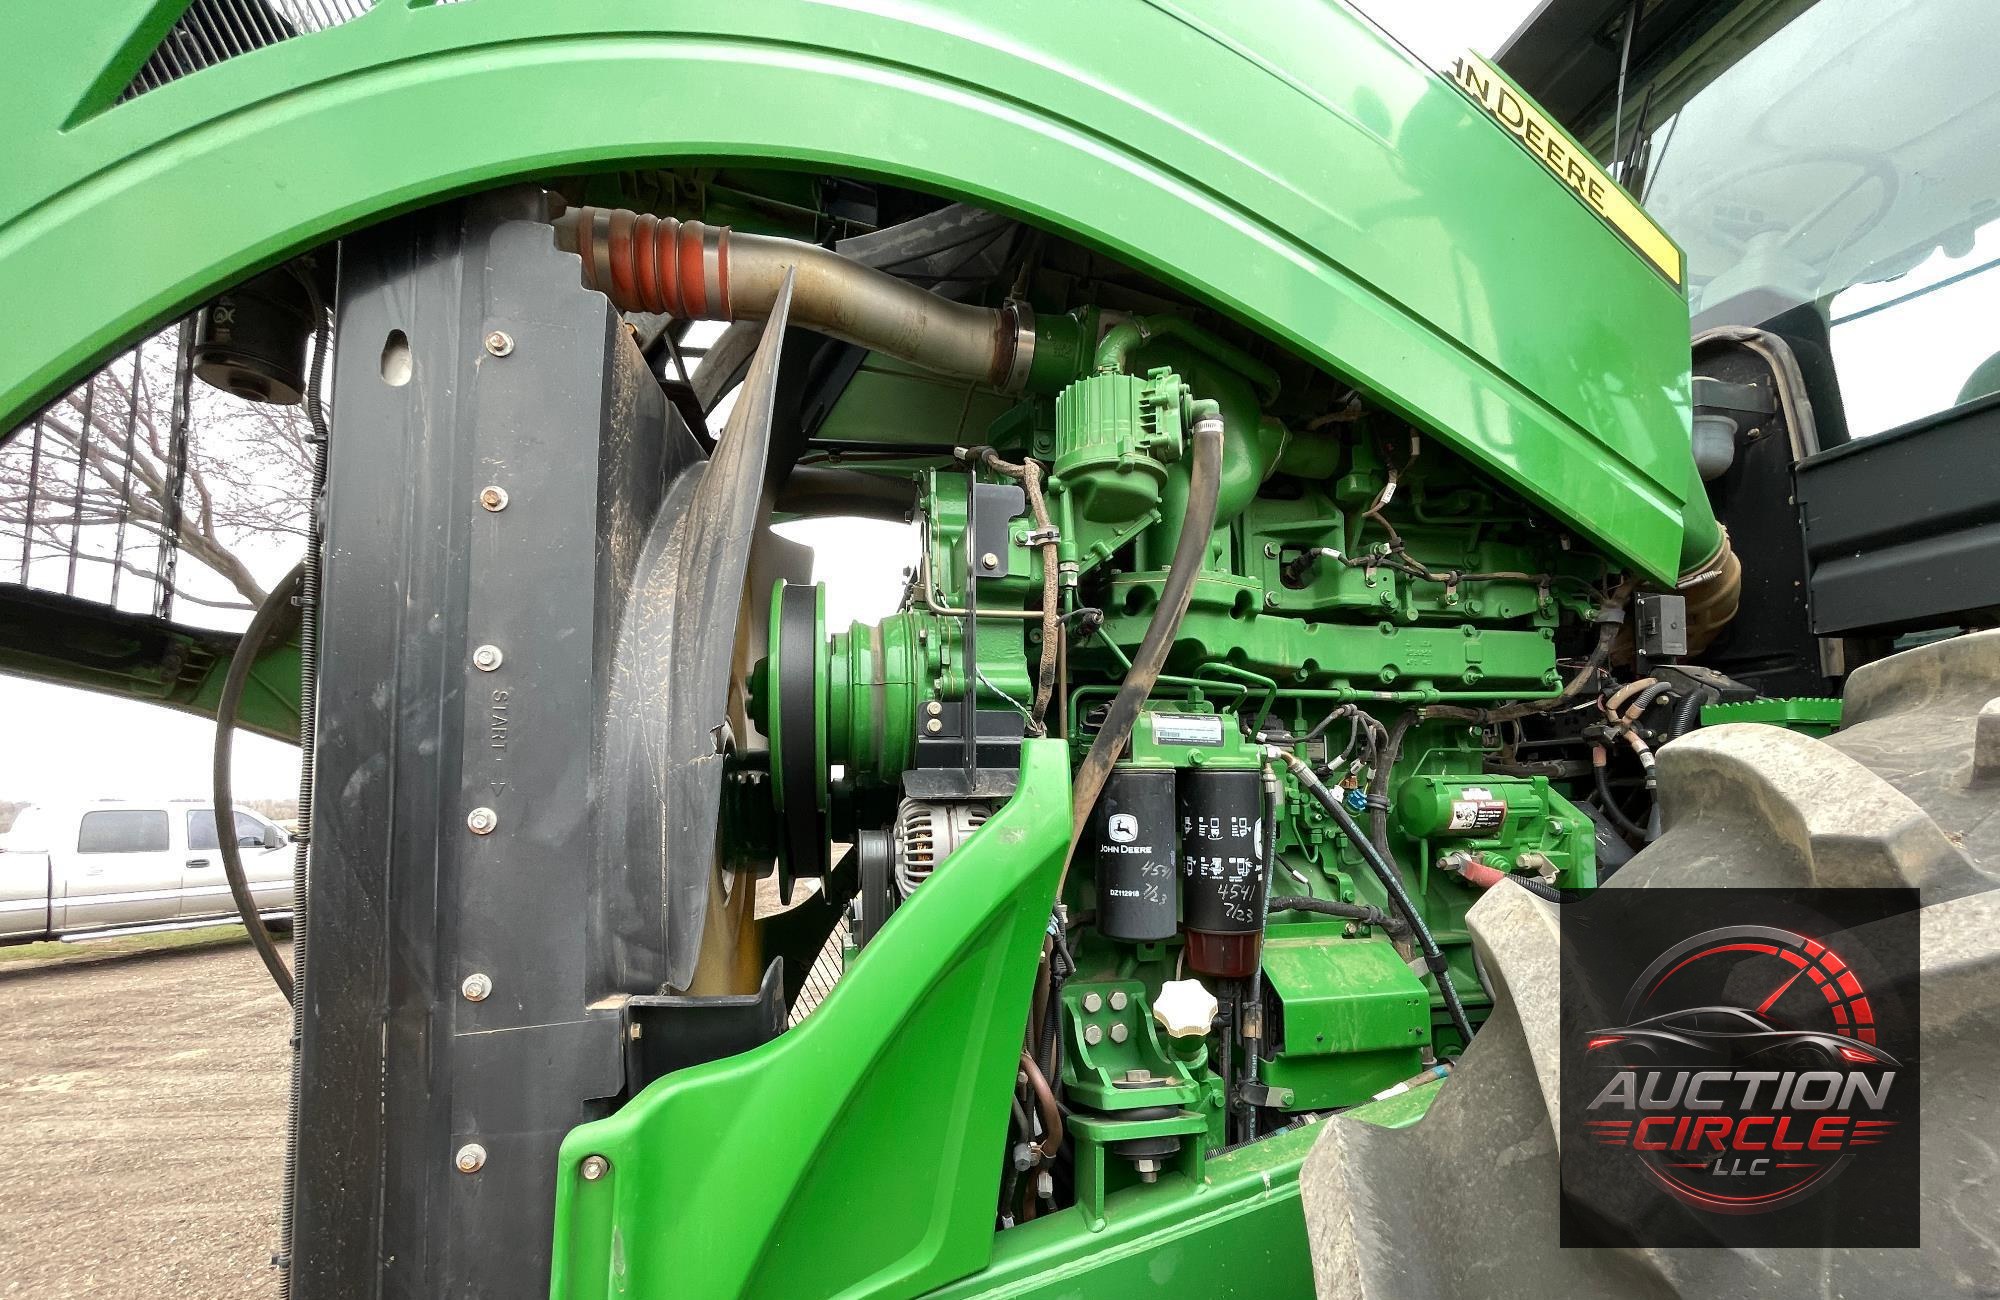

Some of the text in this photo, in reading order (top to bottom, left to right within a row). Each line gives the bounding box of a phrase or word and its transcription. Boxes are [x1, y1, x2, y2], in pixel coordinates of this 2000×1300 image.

[1497, 87, 1605, 211] DEERE
[1100, 844, 1152, 854] JOHN DEERE
[1217, 883, 1256, 901] 4541
[1223, 902, 1254, 923] 7/23
